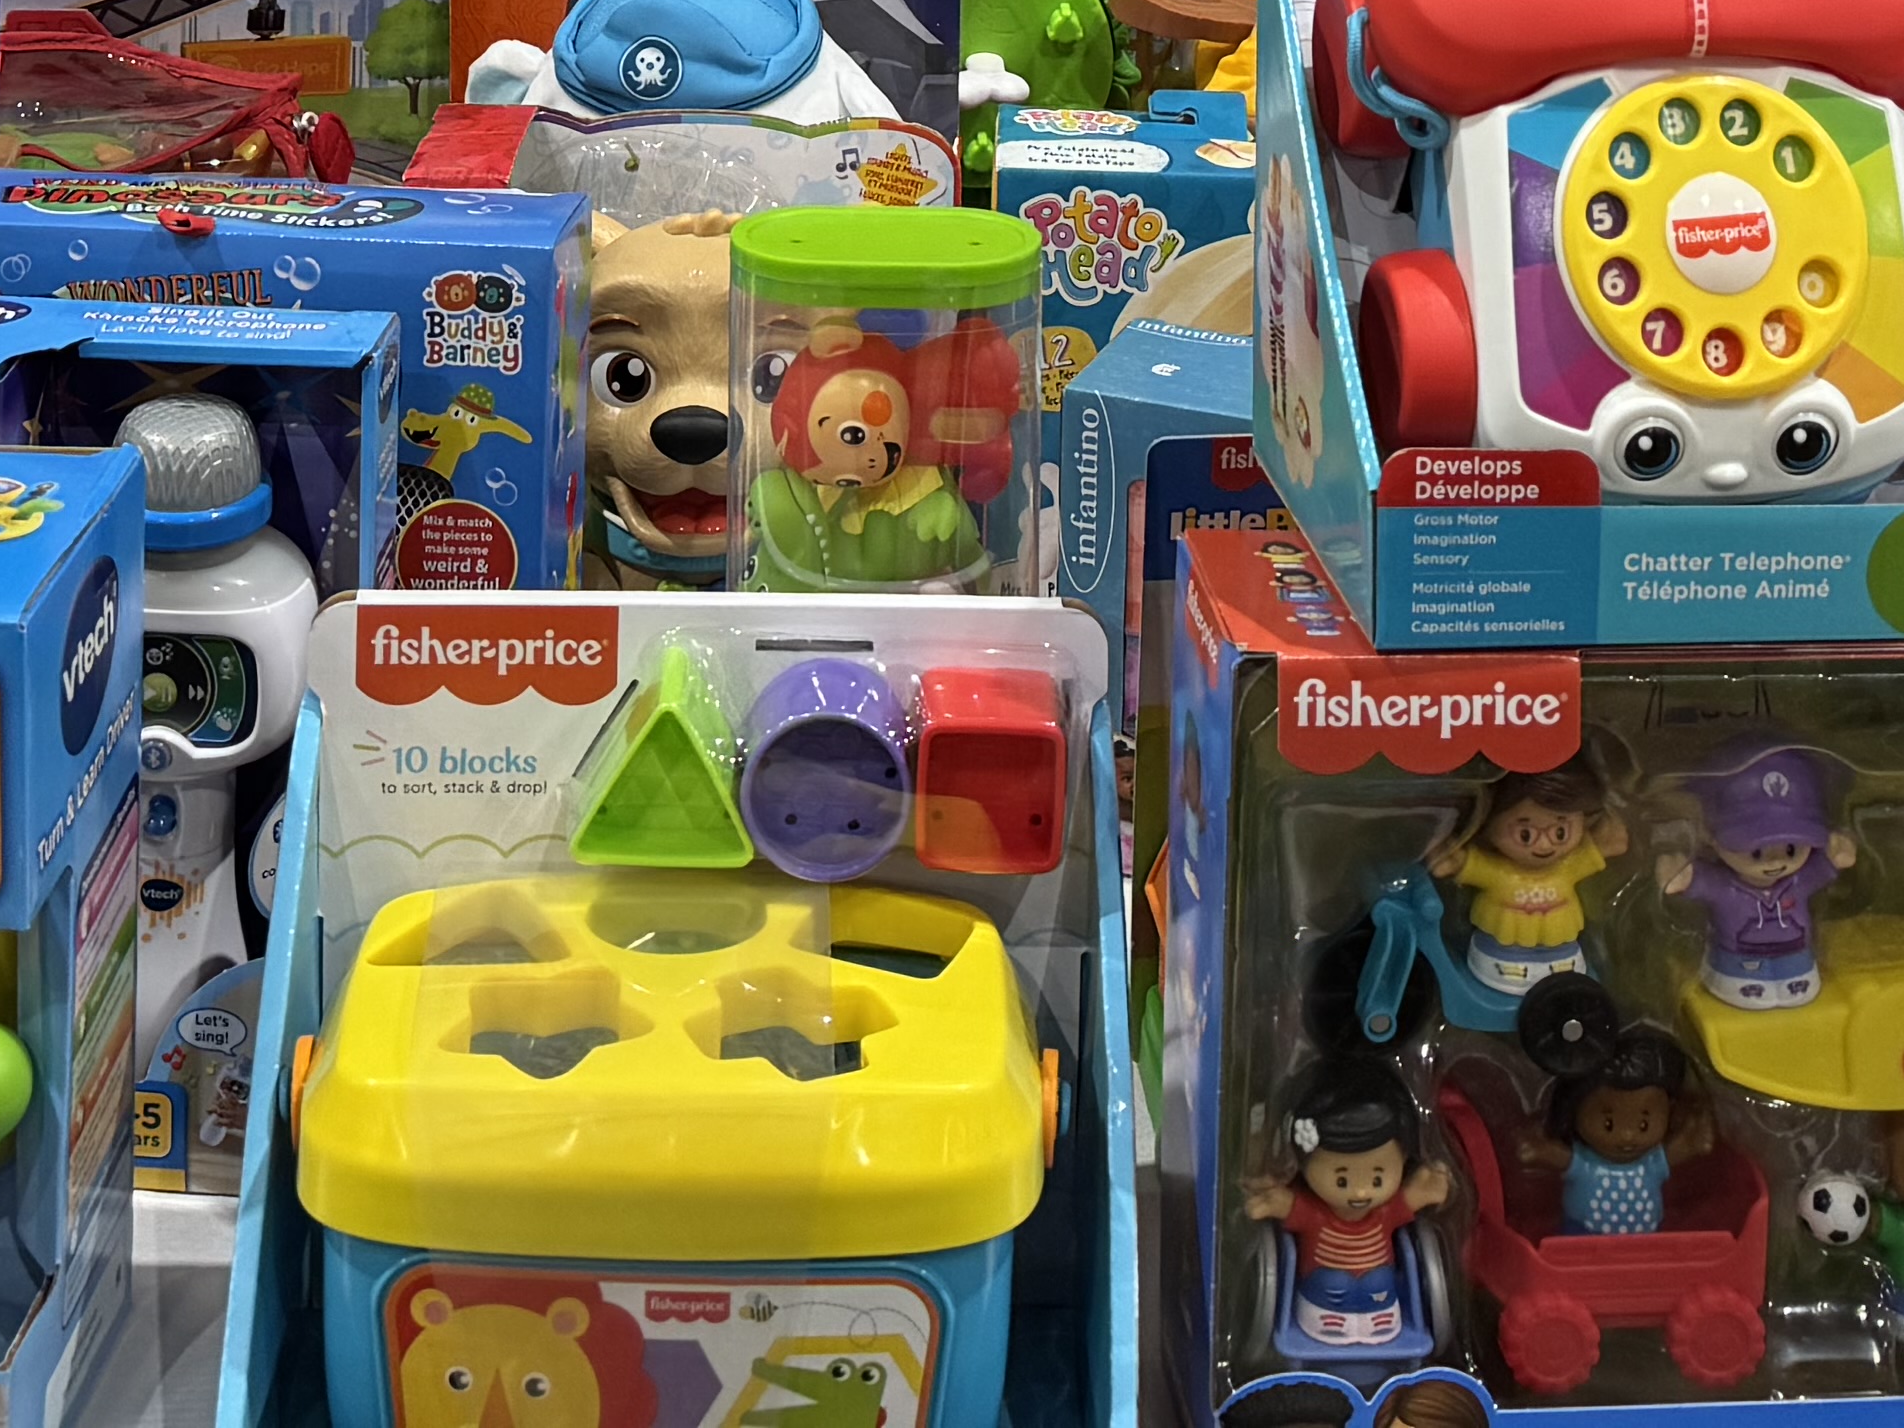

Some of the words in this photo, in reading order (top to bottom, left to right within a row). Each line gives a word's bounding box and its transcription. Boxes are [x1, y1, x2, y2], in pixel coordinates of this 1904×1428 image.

[1724, 110, 1749, 137] 2
[1613, 142, 1636, 170] 4
[1781, 146, 1796, 173] 1
[203, 205, 264, 220] Time
[271, 212, 395, 228] Stickers!
[1021, 186, 1165, 246] Potato
[1592, 203, 1613, 231] 5
[66, 269, 273, 307] WONDERFUL
[427, 343, 520, 374] Barney
[1414, 454, 1523, 479] Develops
[1070, 406, 1099, 567] infantino
[1414, 478, 1541, 502] Développe
[423, 558, 472, 574] weird
[476, 558, 489, 573] &
[1623, 551, 1712, 573] Chatter
[1720, 550, 1845, 576] Telephone
[1623, 577, 1748, 604] Téléphone
[1756, 577, 1831, 600] Animé
[371, 625, 603, 675] fisher-price
[1294, 680, 1561, 738] fisher-price
[393, 747, 428, 773] 10
[439, 745, 537, 774] blocks
[195, 1013, 230, 1028] Let's
[195, 1030, 230, 1046] sing!
[649, 1296, 725, 1317] fisher-price
